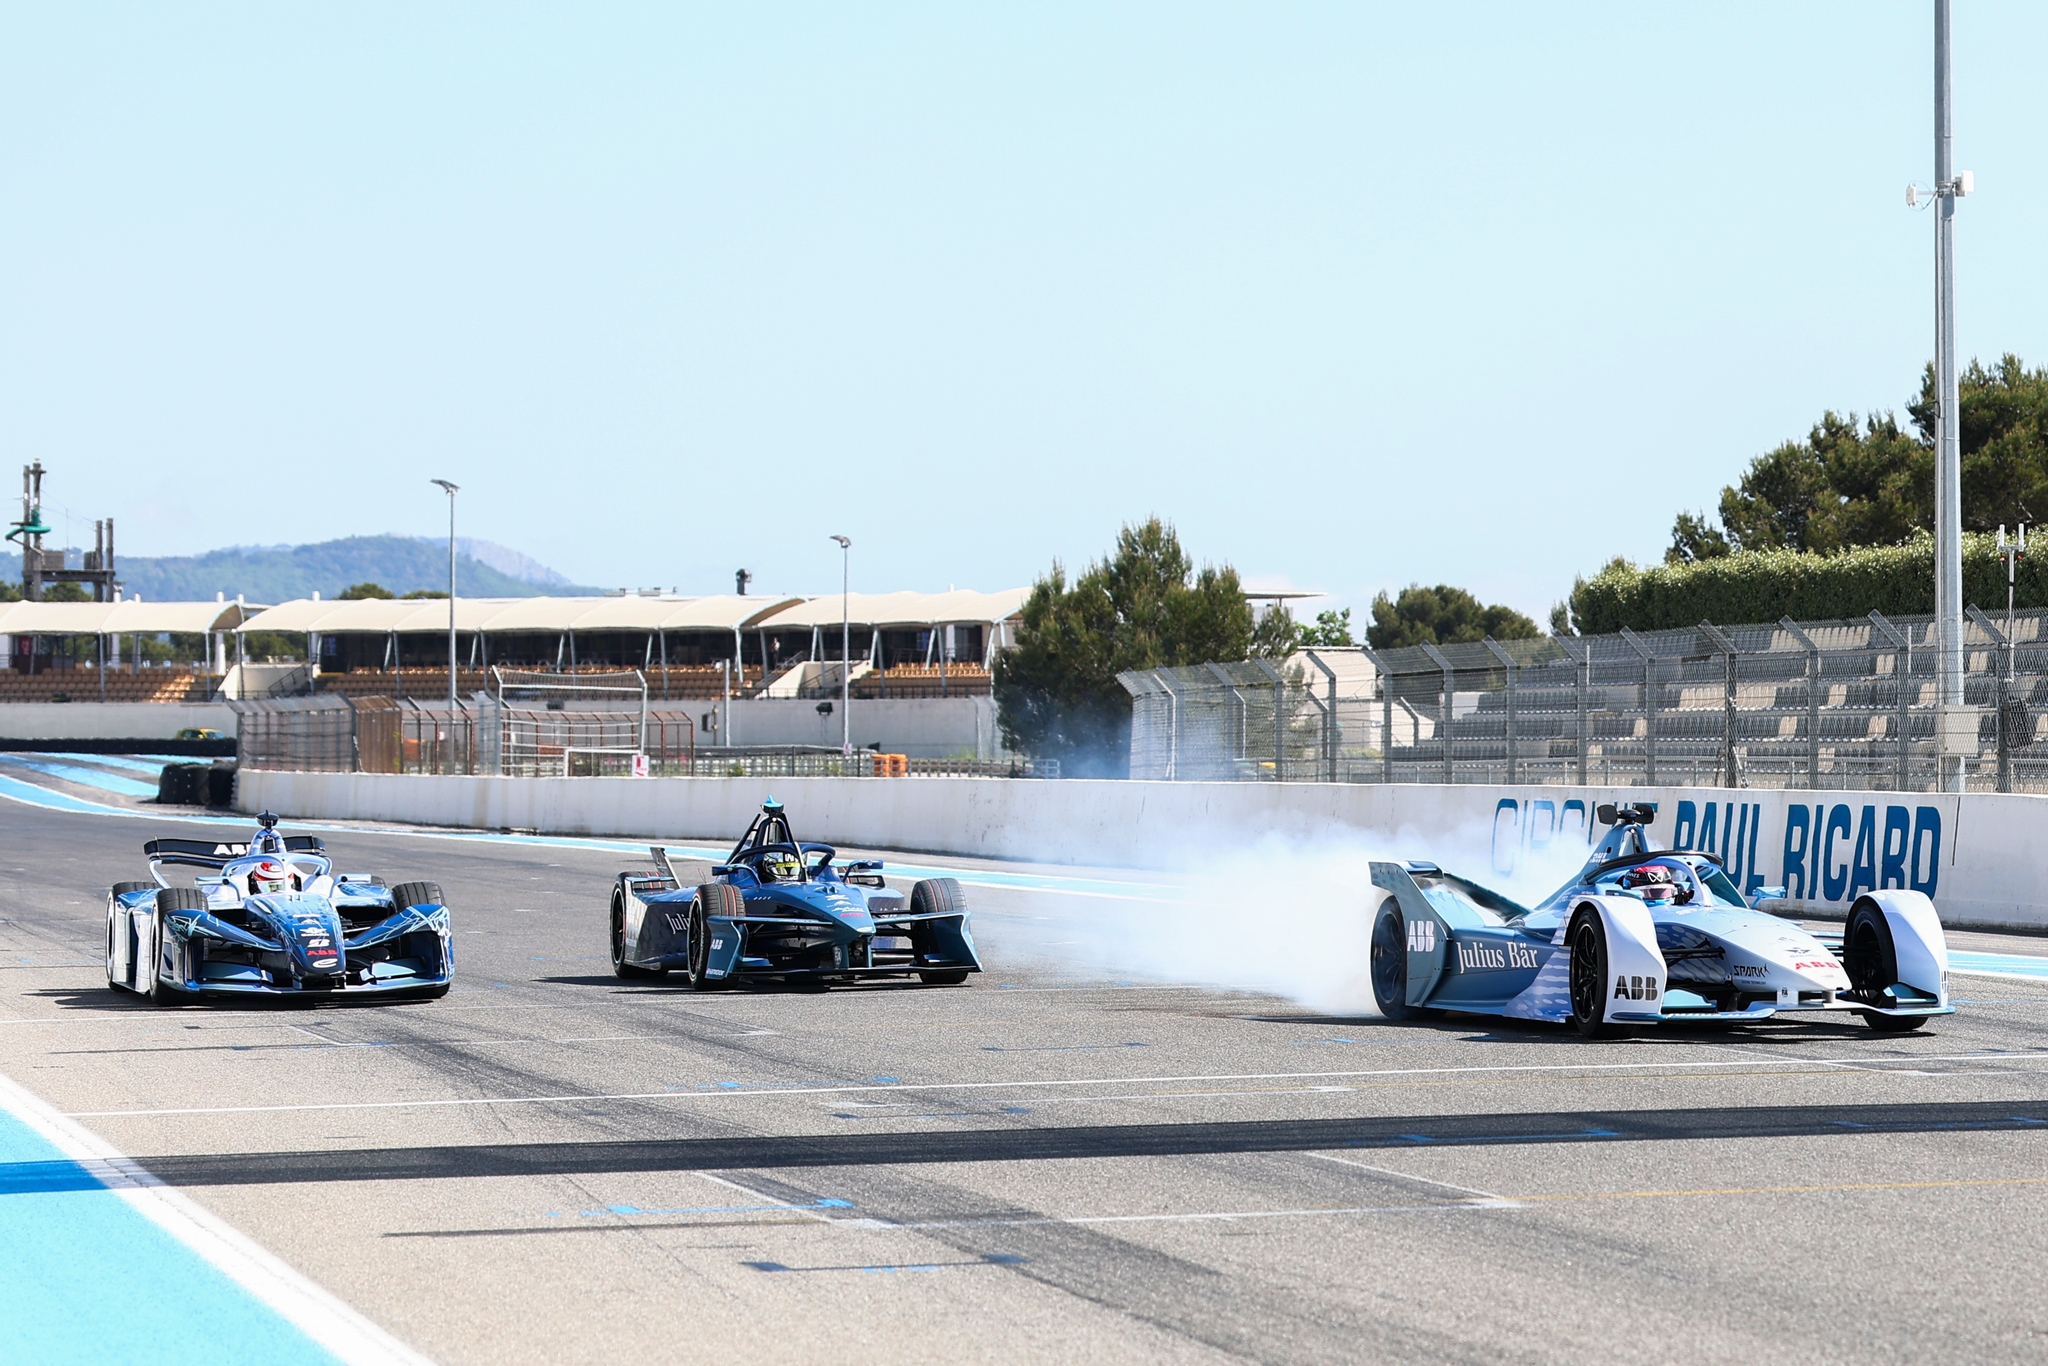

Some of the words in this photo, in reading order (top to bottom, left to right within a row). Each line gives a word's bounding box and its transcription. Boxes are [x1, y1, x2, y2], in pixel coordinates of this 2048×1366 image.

[213, 844, 252, 855] AB
[1783, 803, 1941, 903] RICARD
[710, 938, 723, 950] ABB
[1407, 920, 1435, 952] ABB
[1456, 941, 1505, 974] Julius
[1506, 941, 1539, 969] Bär
[1795, 961, 1840, 970] ABB
[1733, 965, 1766, 978] SPARK
[1613, 975, 1658, 1001] ABB
